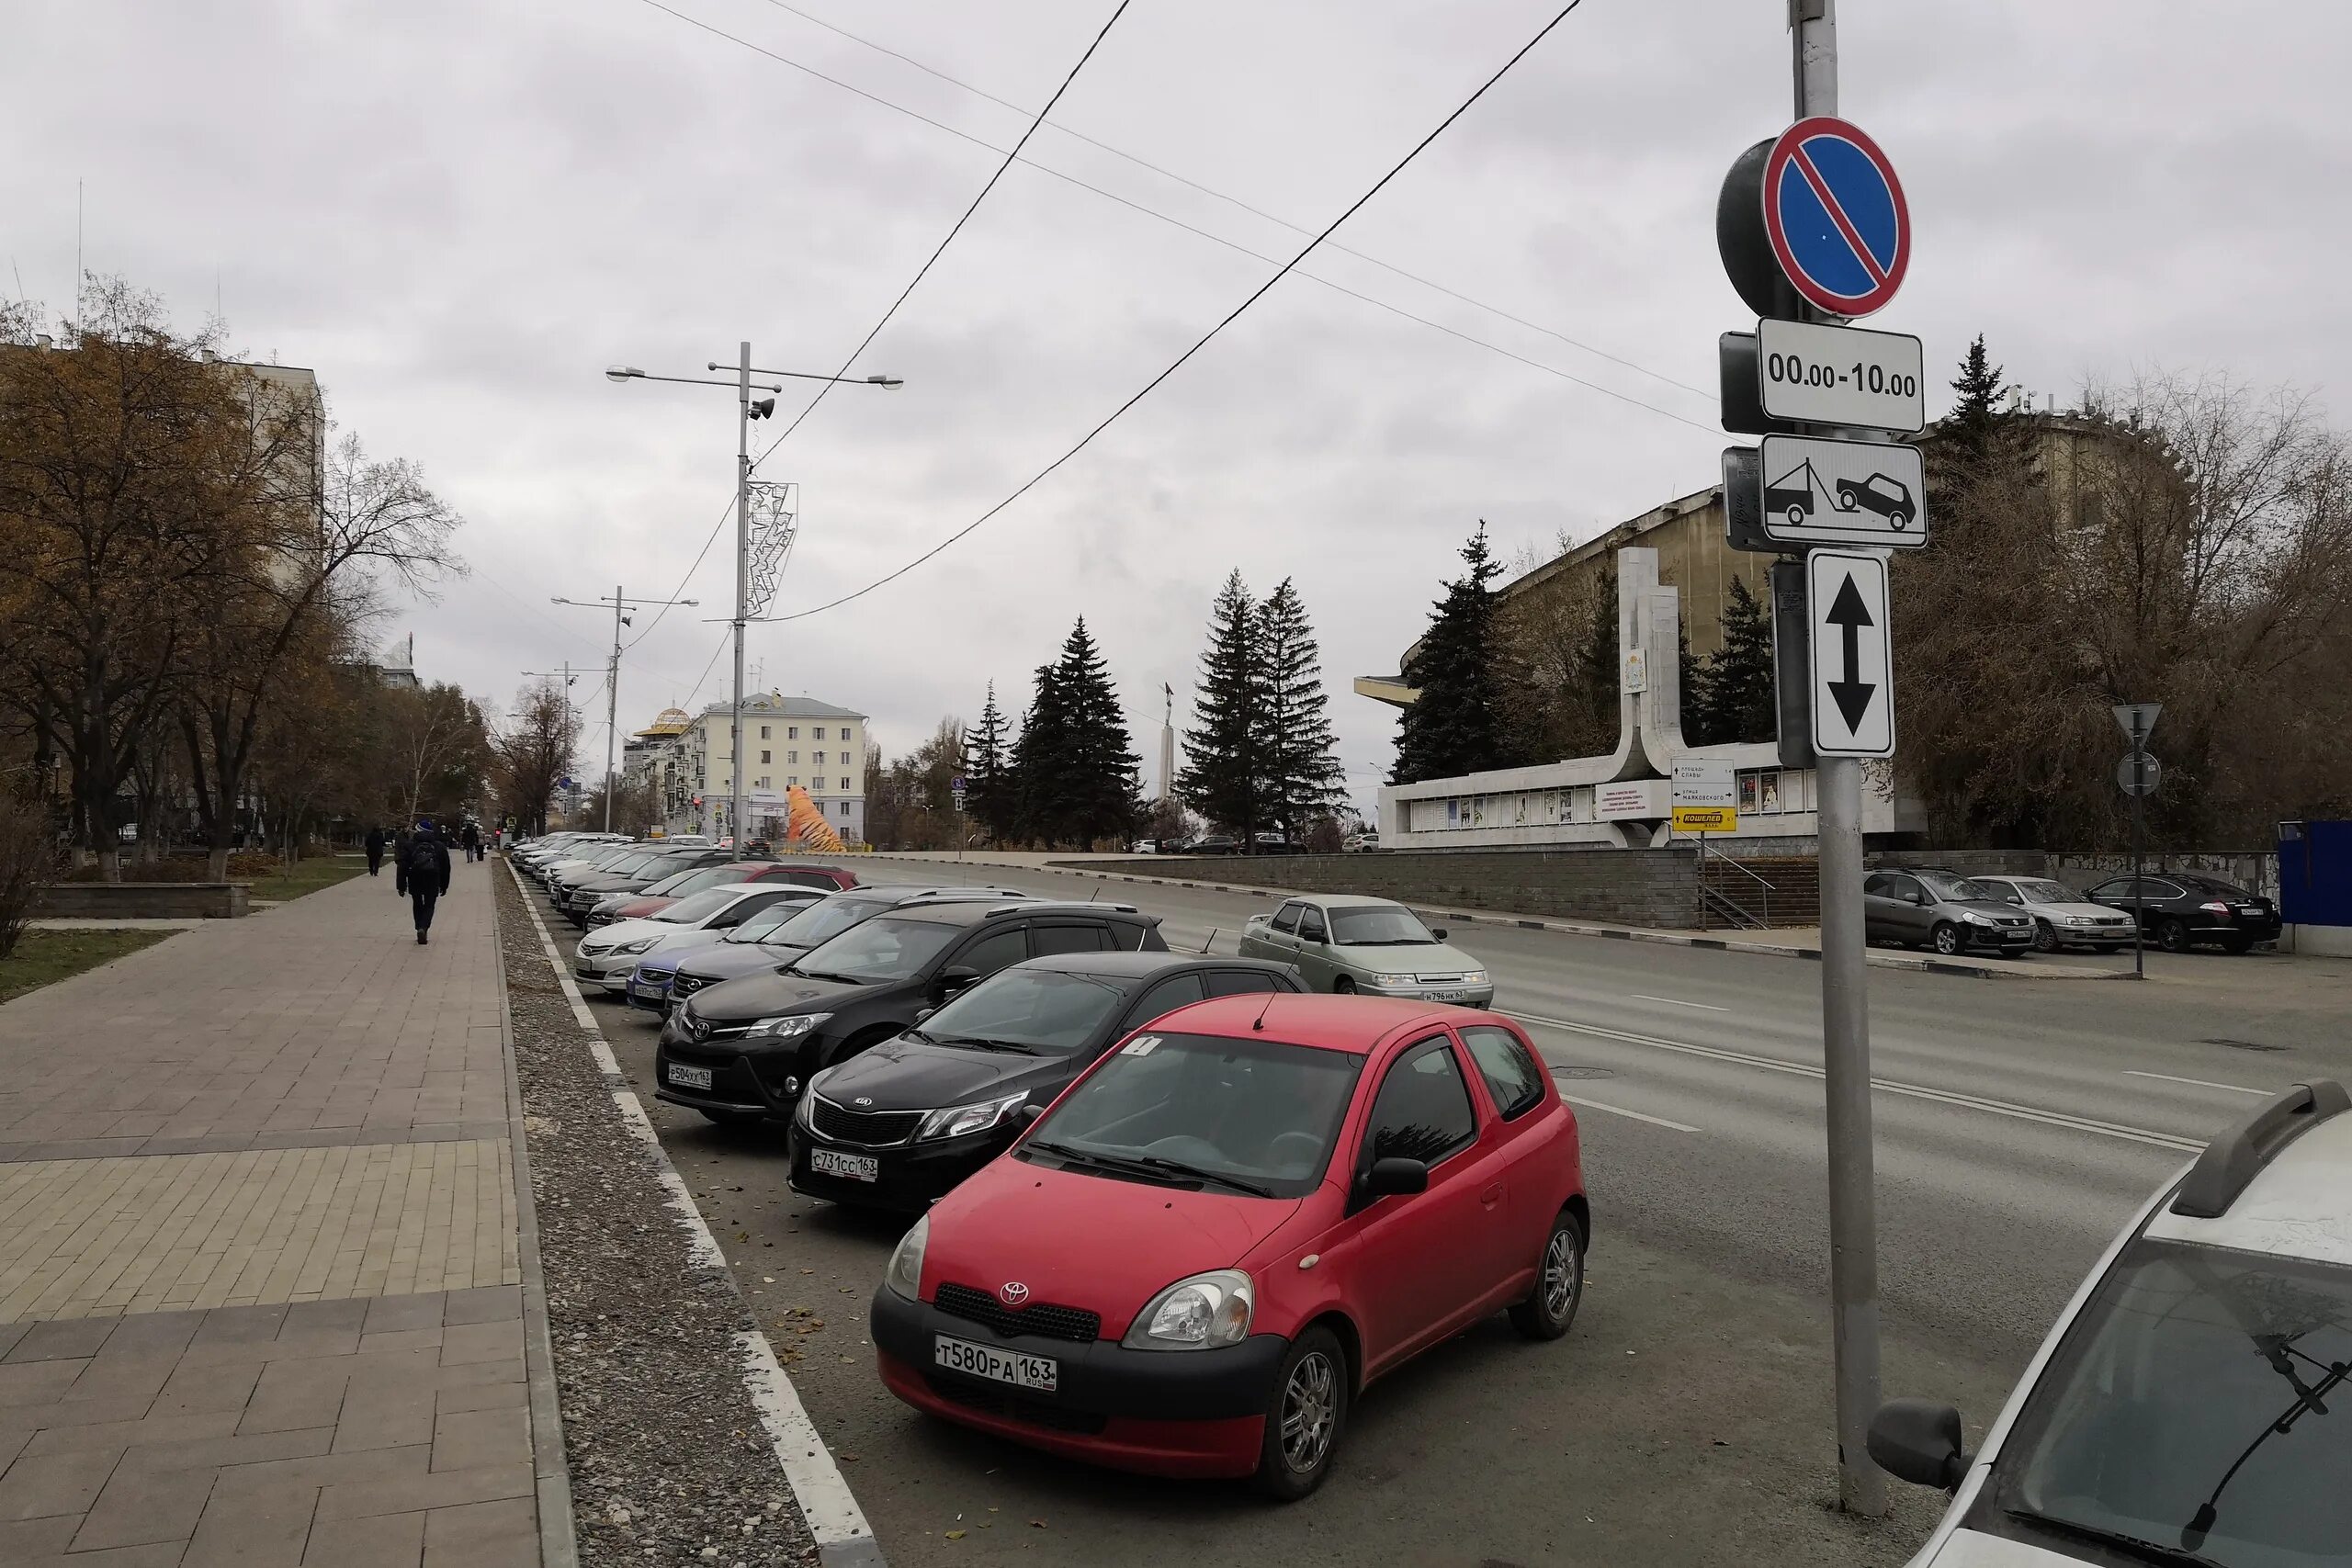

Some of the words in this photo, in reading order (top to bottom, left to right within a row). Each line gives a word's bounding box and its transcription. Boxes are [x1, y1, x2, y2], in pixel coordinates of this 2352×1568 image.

[1769, 353, 1916, 398] 00.00-10.00
[857, 1157, 876, 1172] 163
[1019, 1358, 1052, 1381] 163
[1025, 1377, 1043, 1387] RUS
